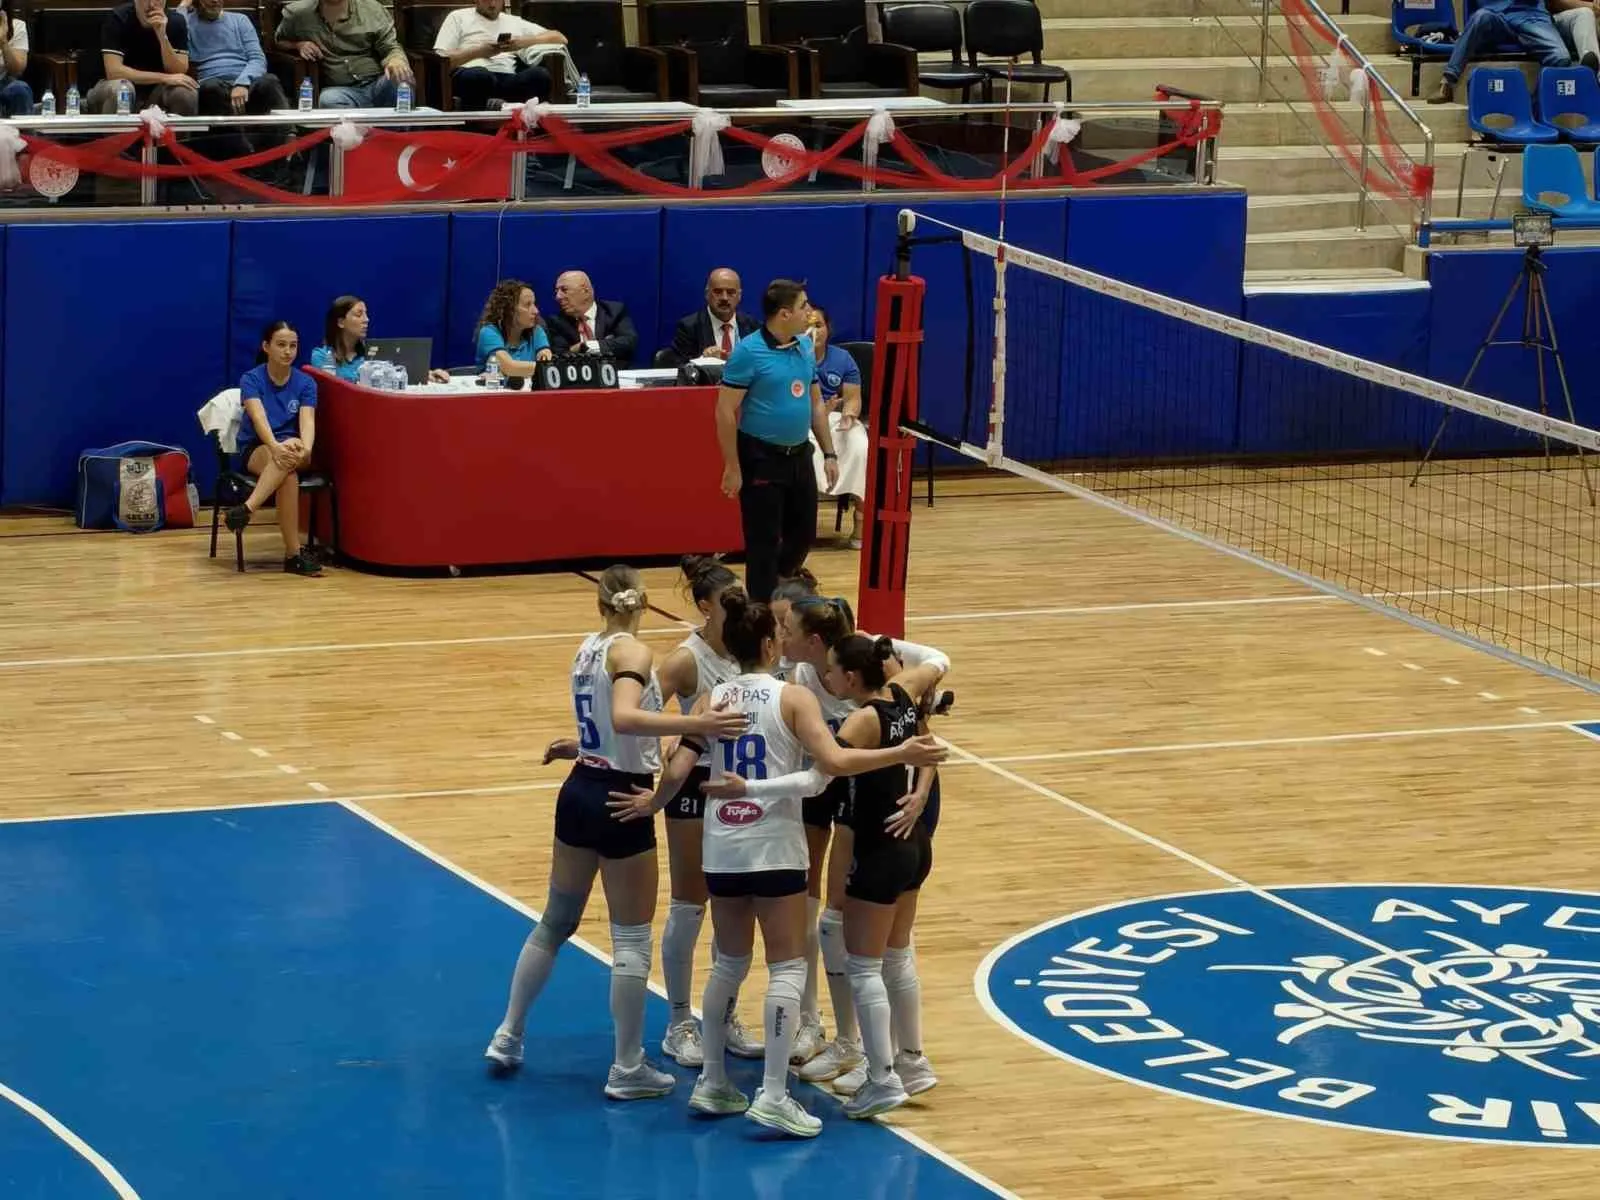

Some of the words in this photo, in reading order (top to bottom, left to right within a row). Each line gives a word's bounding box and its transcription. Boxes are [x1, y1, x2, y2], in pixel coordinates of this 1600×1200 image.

[575, 694, 600, 749] 5
[718, 734, 767, 780] 18
[680, 797, 697, 814] 21
